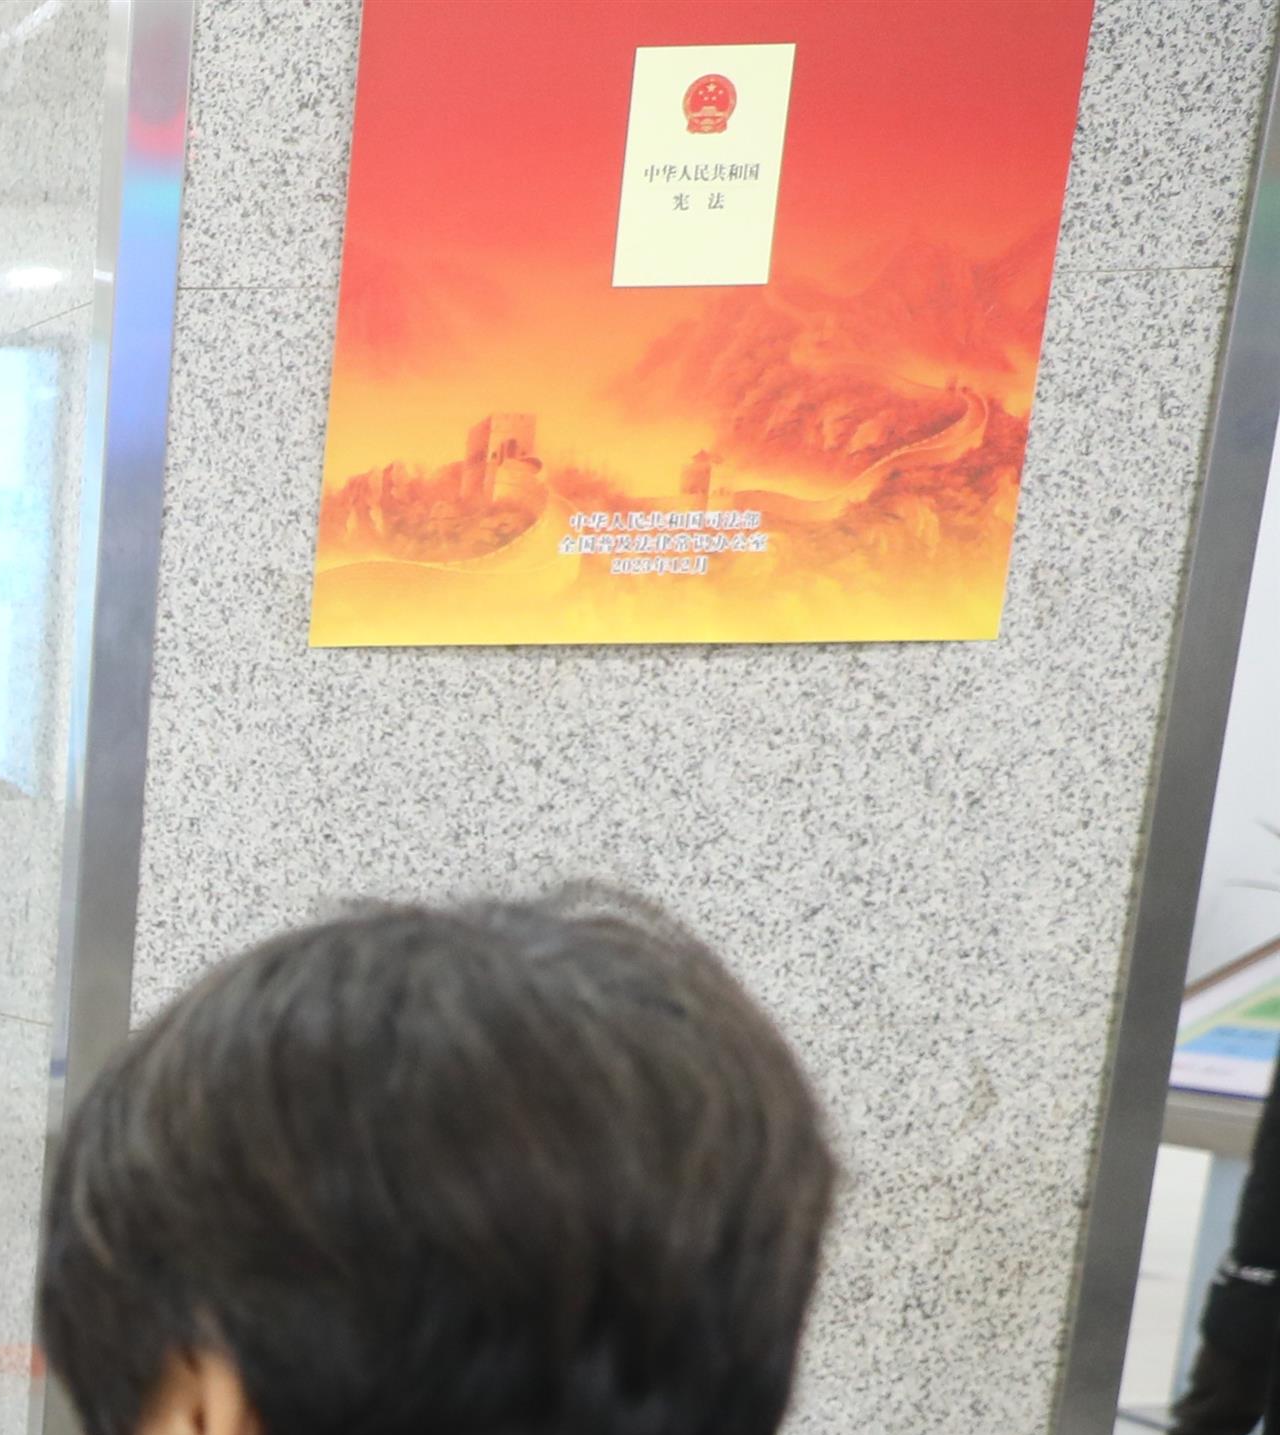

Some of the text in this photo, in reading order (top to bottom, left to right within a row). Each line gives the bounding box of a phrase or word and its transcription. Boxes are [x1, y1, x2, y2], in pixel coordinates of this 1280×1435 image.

[644, 163, 760, 183] 中华人民共和国
[570, 510, 761, 531] 中华人民共和国司法部
[559, 534, 768, 553] 全国普及法律常识办公室
